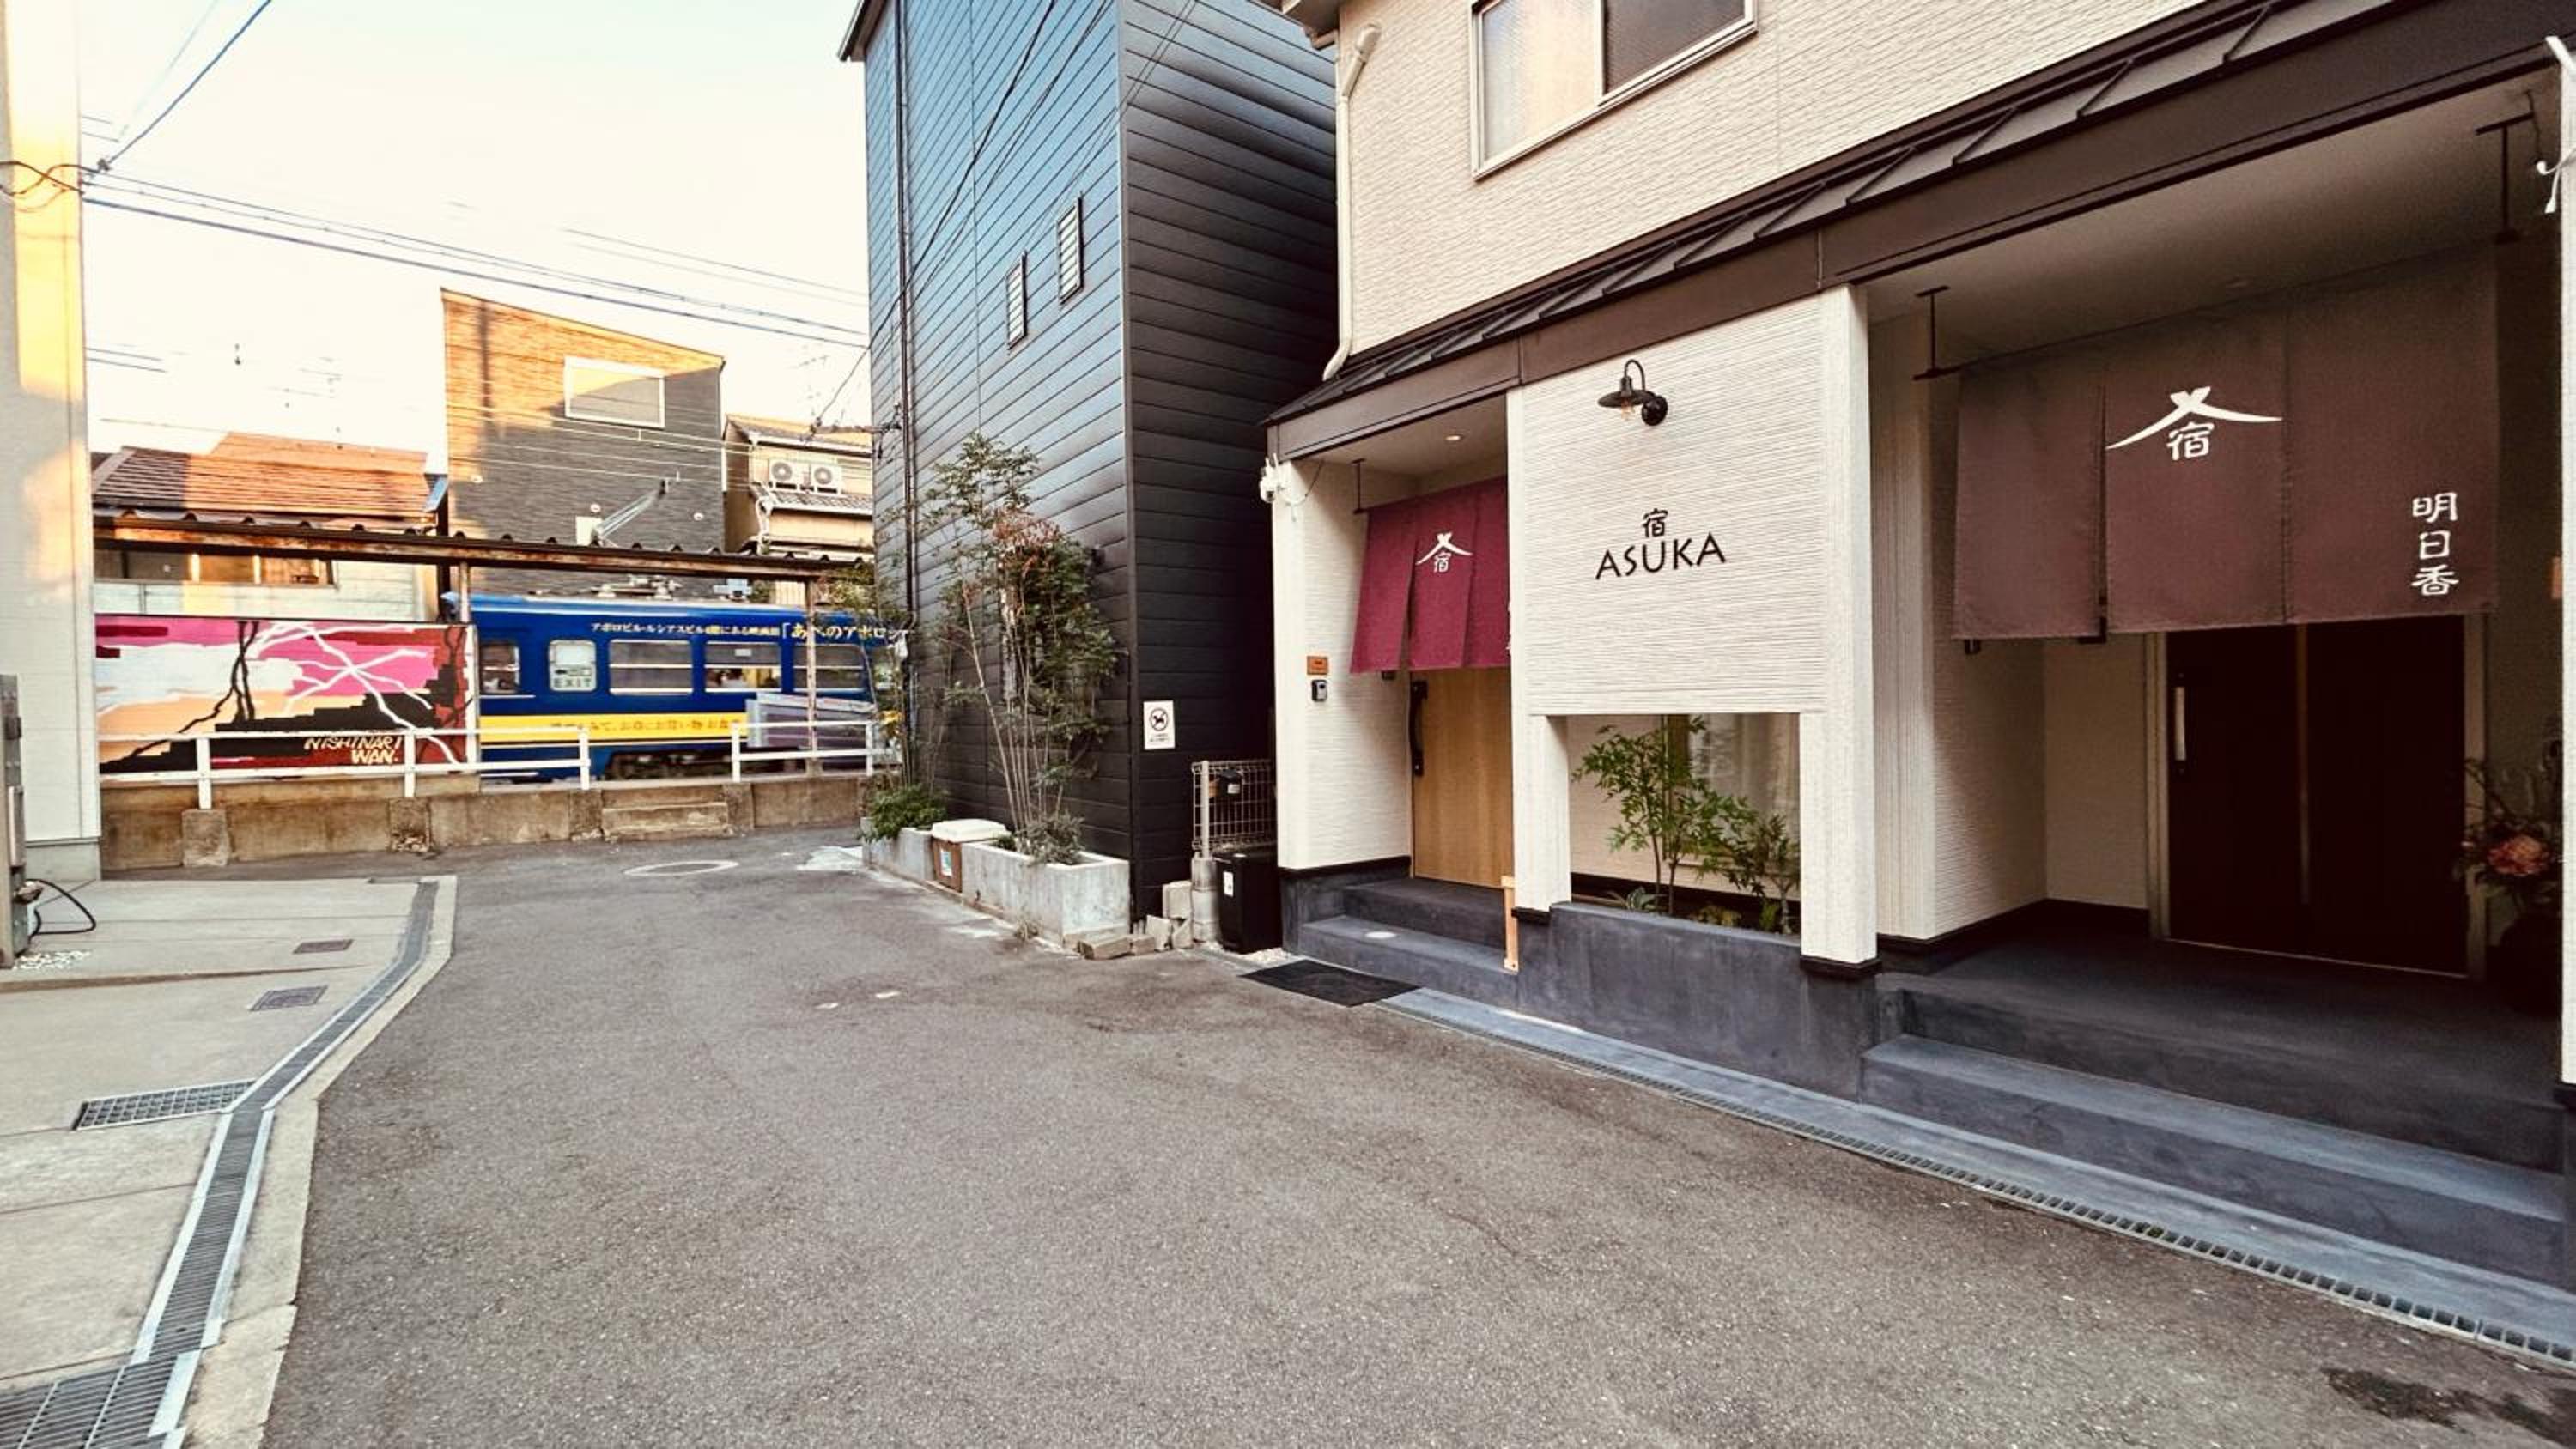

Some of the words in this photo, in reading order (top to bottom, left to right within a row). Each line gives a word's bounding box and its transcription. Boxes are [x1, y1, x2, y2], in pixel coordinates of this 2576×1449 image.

[2166, 421, 2215, 461] 宿
[1642, 508, 1668, 538] 宿
[1595, 532, 1727, 580] ASUKA
[2411, 491, 2459, 596] 明日香
[1433, 551, 1452, 573] 宿
[553, 677, 592, 688] EXIT
[304, 736, 402, 749] NISHINARI
